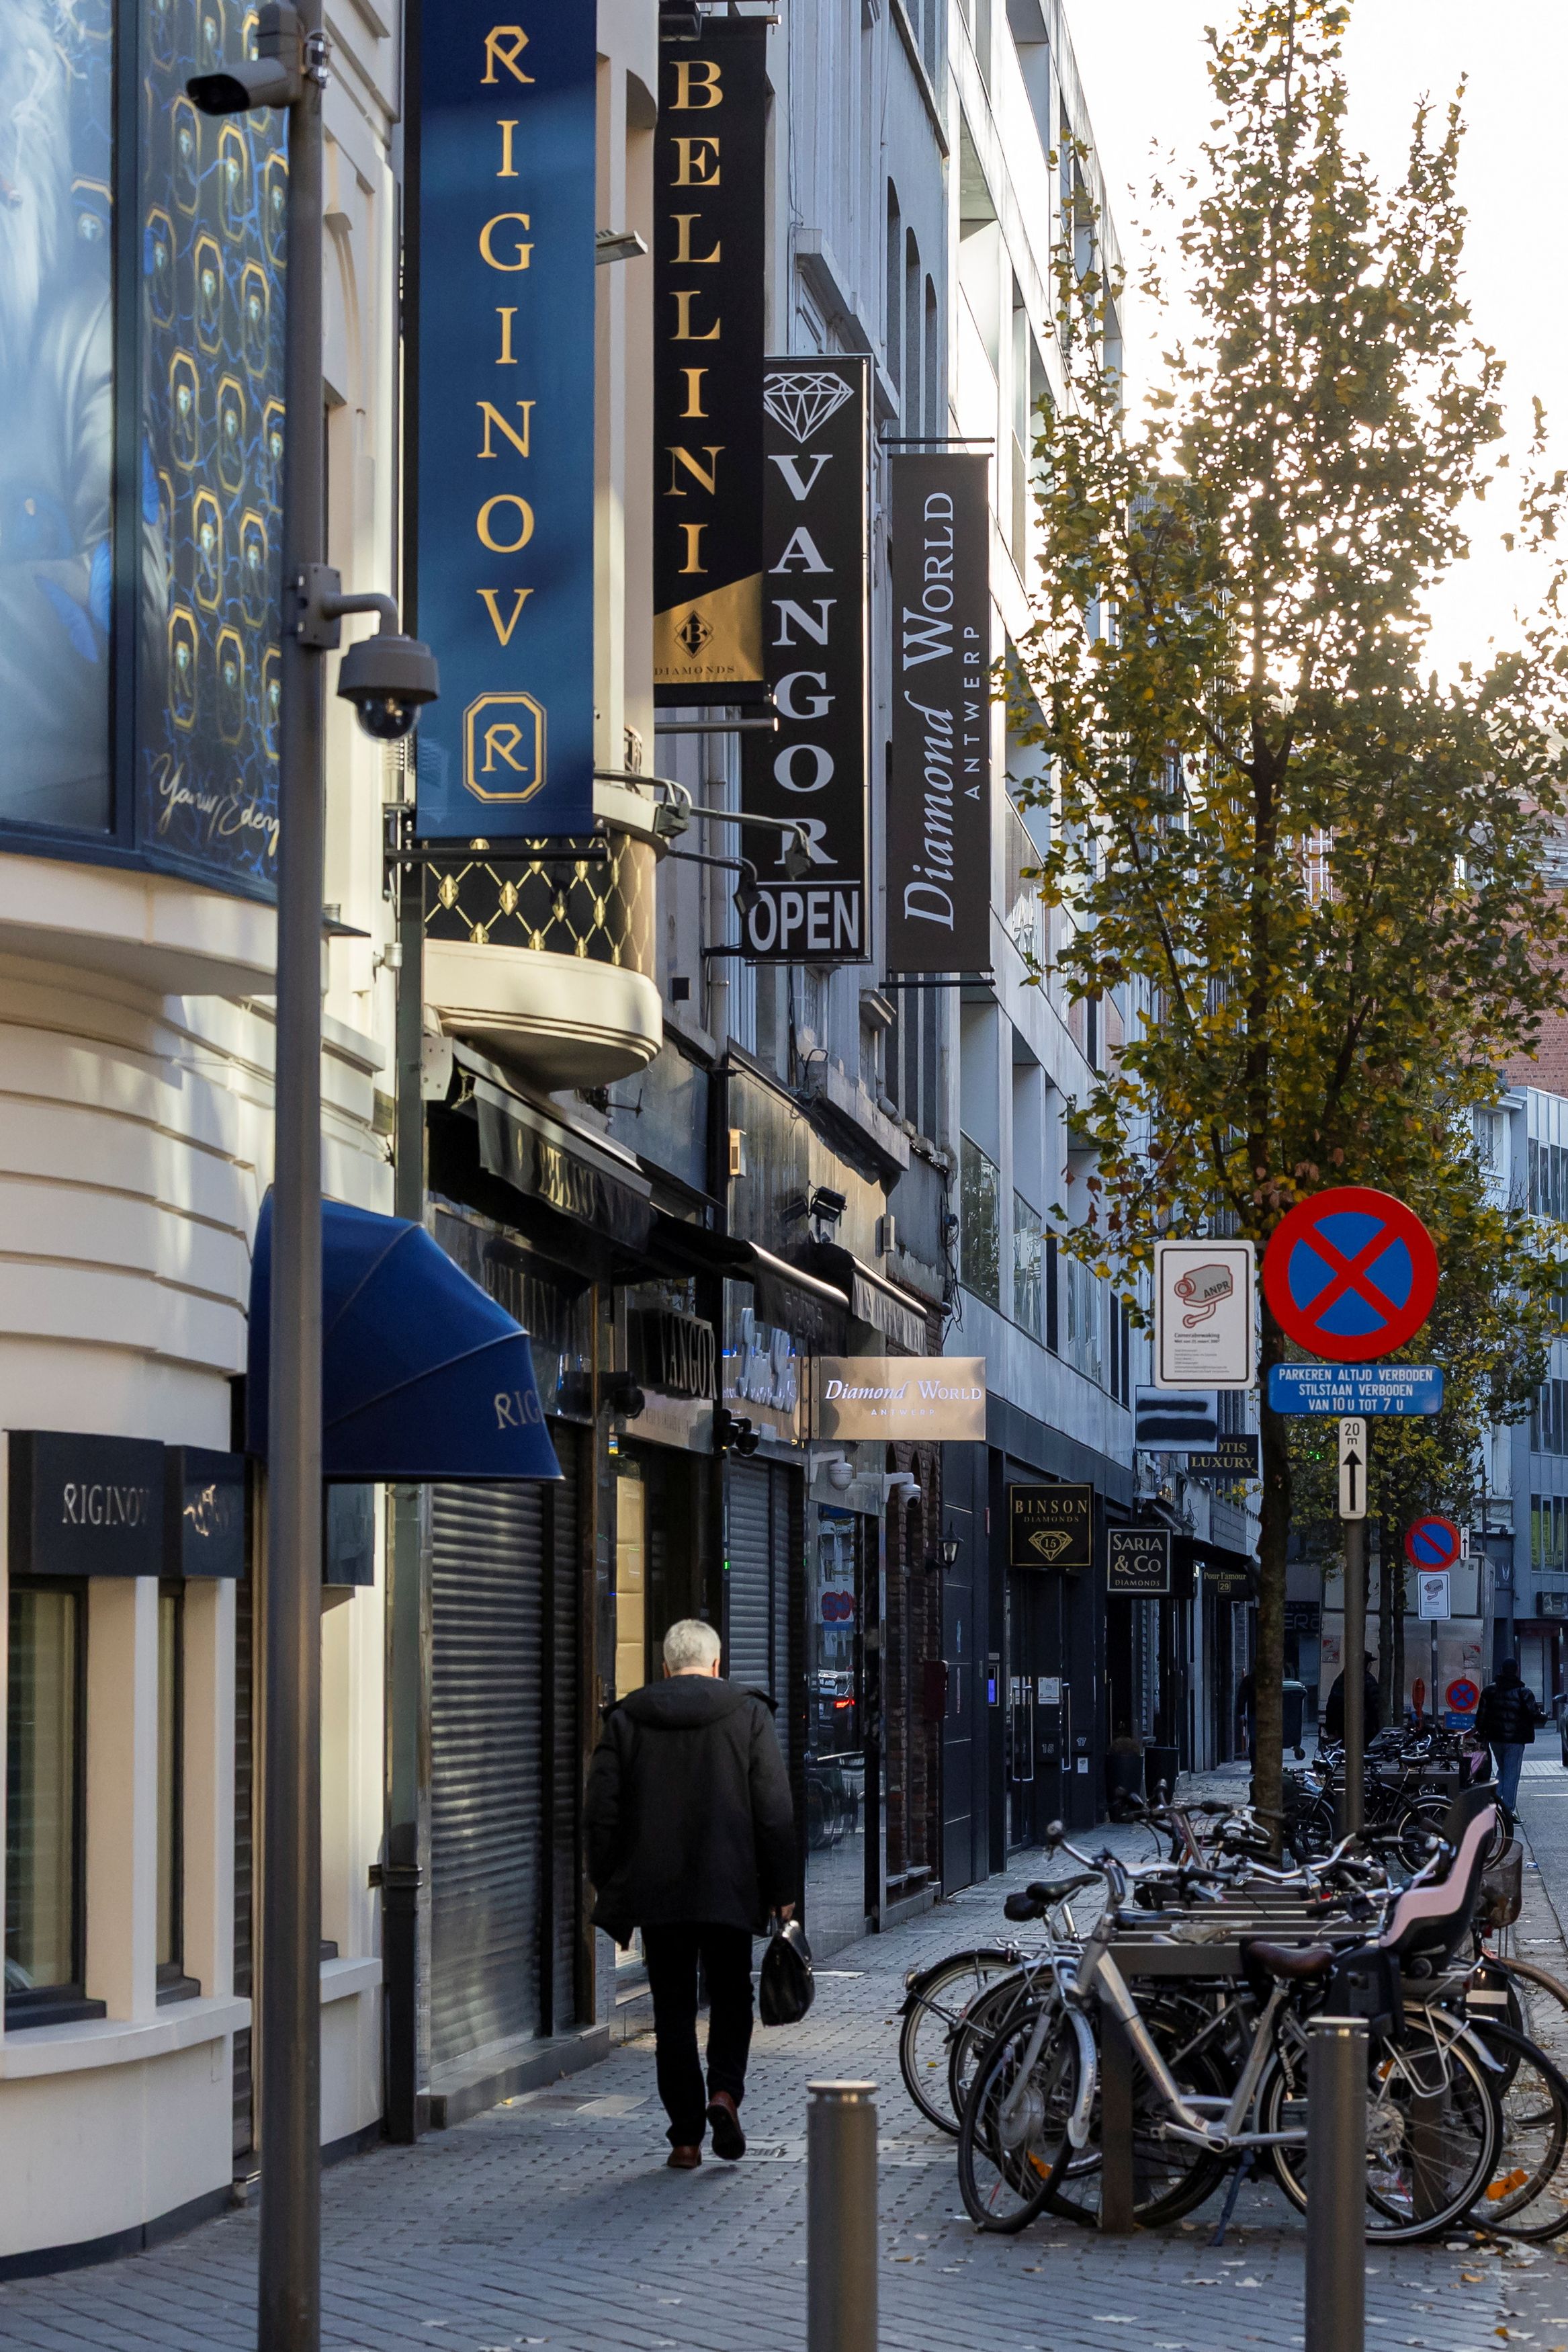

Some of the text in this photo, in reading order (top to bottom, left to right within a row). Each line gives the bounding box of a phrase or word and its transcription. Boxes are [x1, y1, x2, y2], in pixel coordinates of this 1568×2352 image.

[662, 60, 726, 573] BELLINI
[476, 26, 535, 646] RIGINOV
[767, 454, 838, 865] VANGOR
[654, 665, 735, 675] DIAMONDS
[964, 626, 979, 800] ANTWERP
[481, 724, 528, 771] R
[904, 690, 953, 931] Diamond
[748, 890, 859, 952] OPEN
[1203, 1280, 1230, 1298] ANPR
[1279, 1369, 1433, 1381] PARKEREN ALTIJD VERBODEN
[824, 1380, 910, 1400] Diamond
[1299, 1384, 1413, 1396] STILSTAAN VERBODEN
[1309, 1398, 1403, 1411] VAN 10 U TOT 7 U
[1344, 1423, 1360, 1436] 20
[1191, 1457, 1254, 1468] LUXURY
[1014, 1500, 1088, 1513] BINSON
[1045, 1538, 1057, 1548] 15
[1115, 1555, 1135, 1574] &
[1204, 1572, 1219, 1580] Pour
